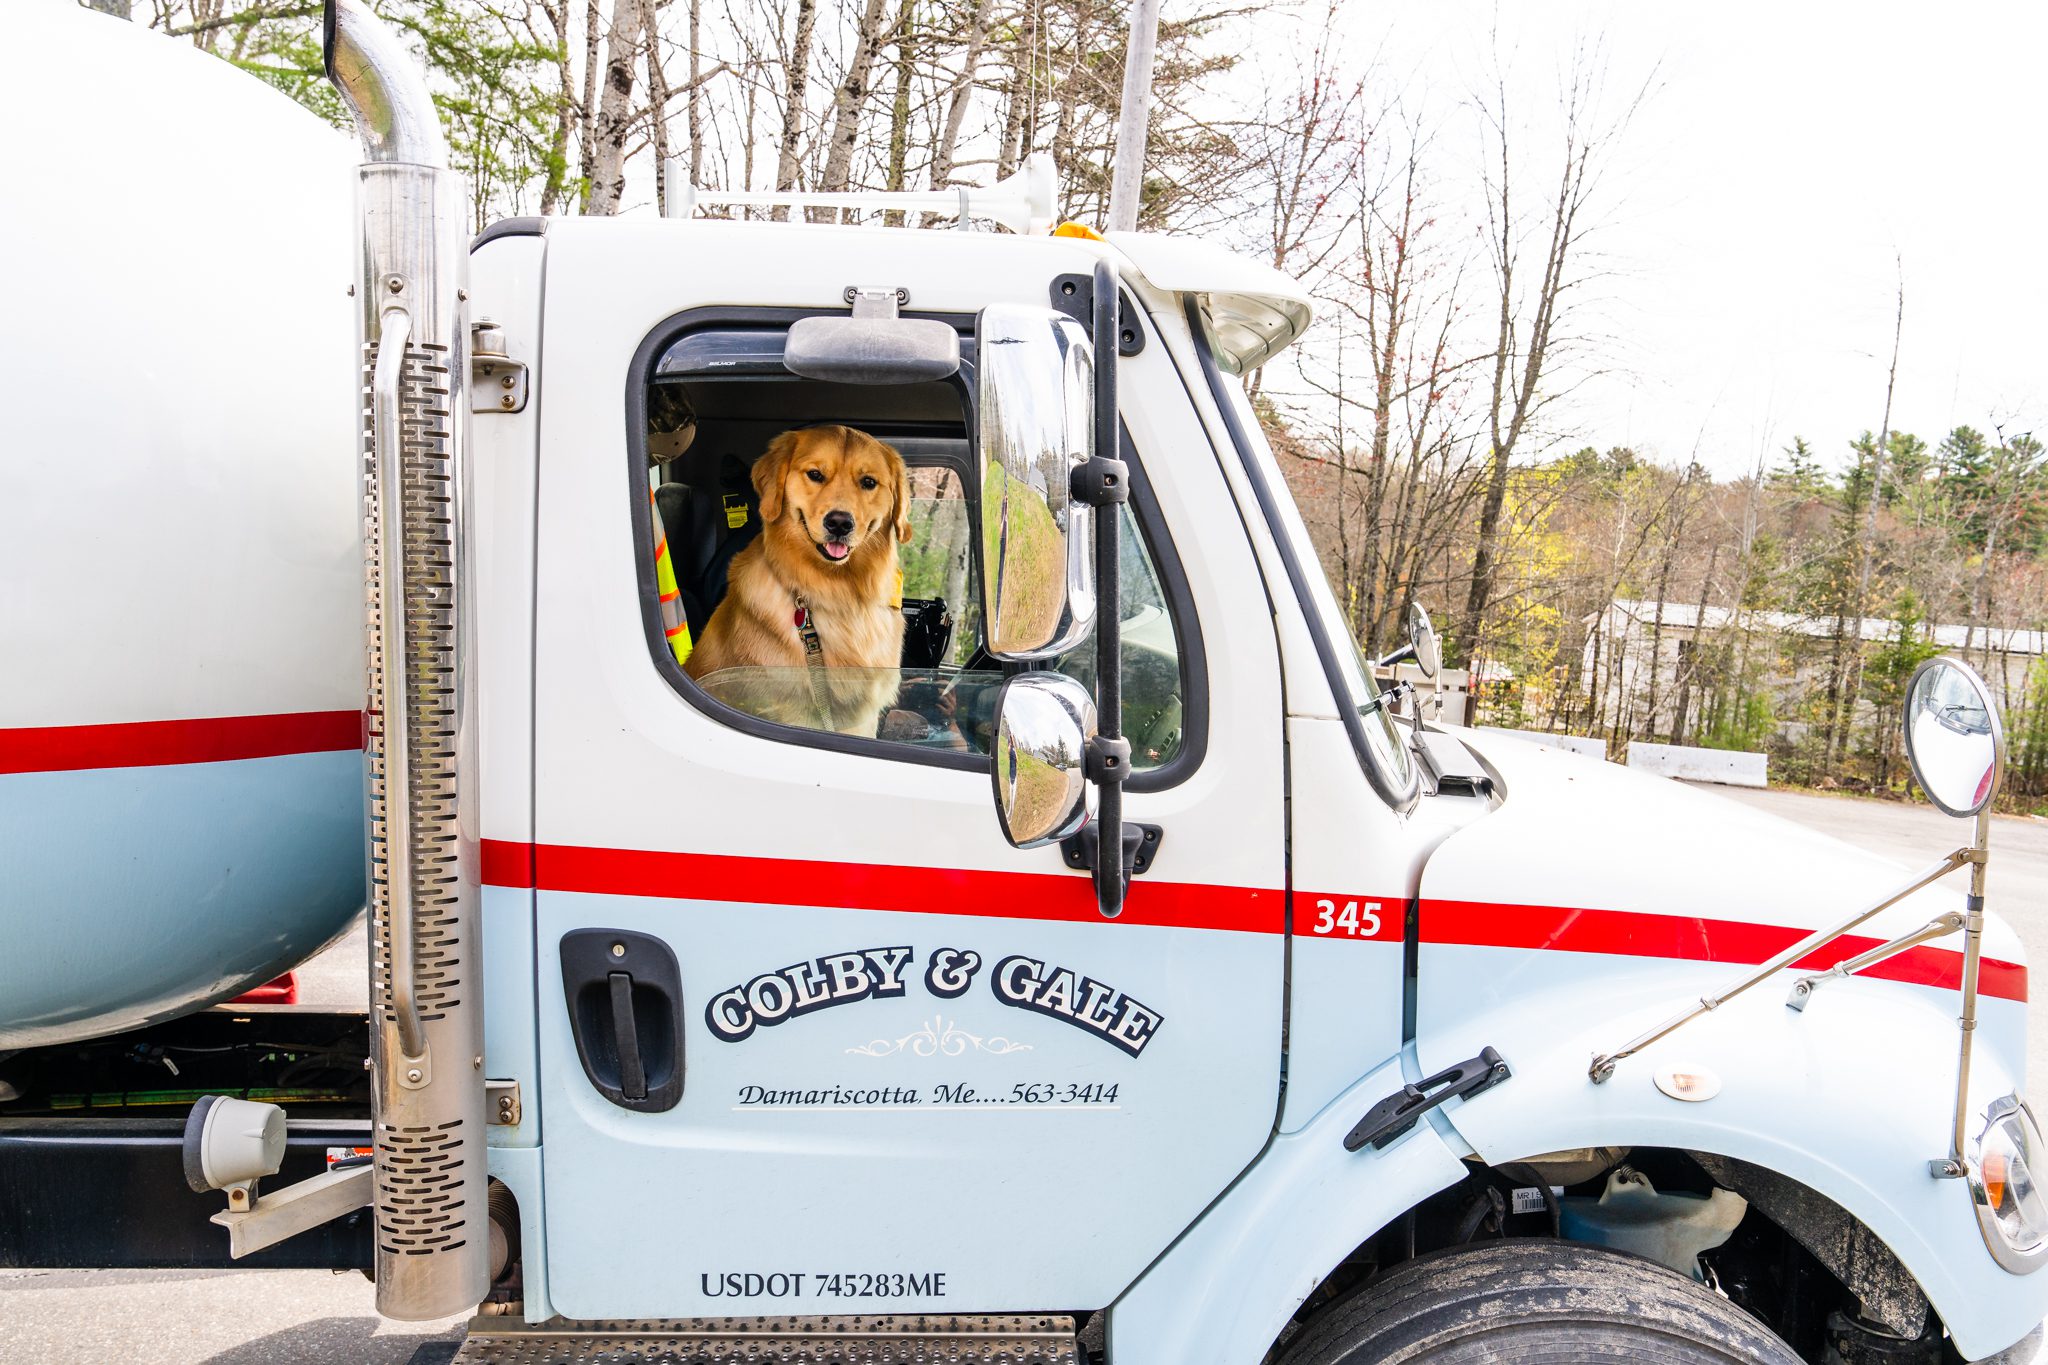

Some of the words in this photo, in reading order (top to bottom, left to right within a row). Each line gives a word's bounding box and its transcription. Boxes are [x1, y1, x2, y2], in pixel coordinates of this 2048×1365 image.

[1313, 899, 1382, 937] 345
[705, 946, 914, 1043] COLBY
[924, 948, 982, 1000] &
[991, 955, 1165, 1059] GALE
[701, 1272, 806, 1298] USDOT
[815, 1272, 946, 1298] 745283ME
